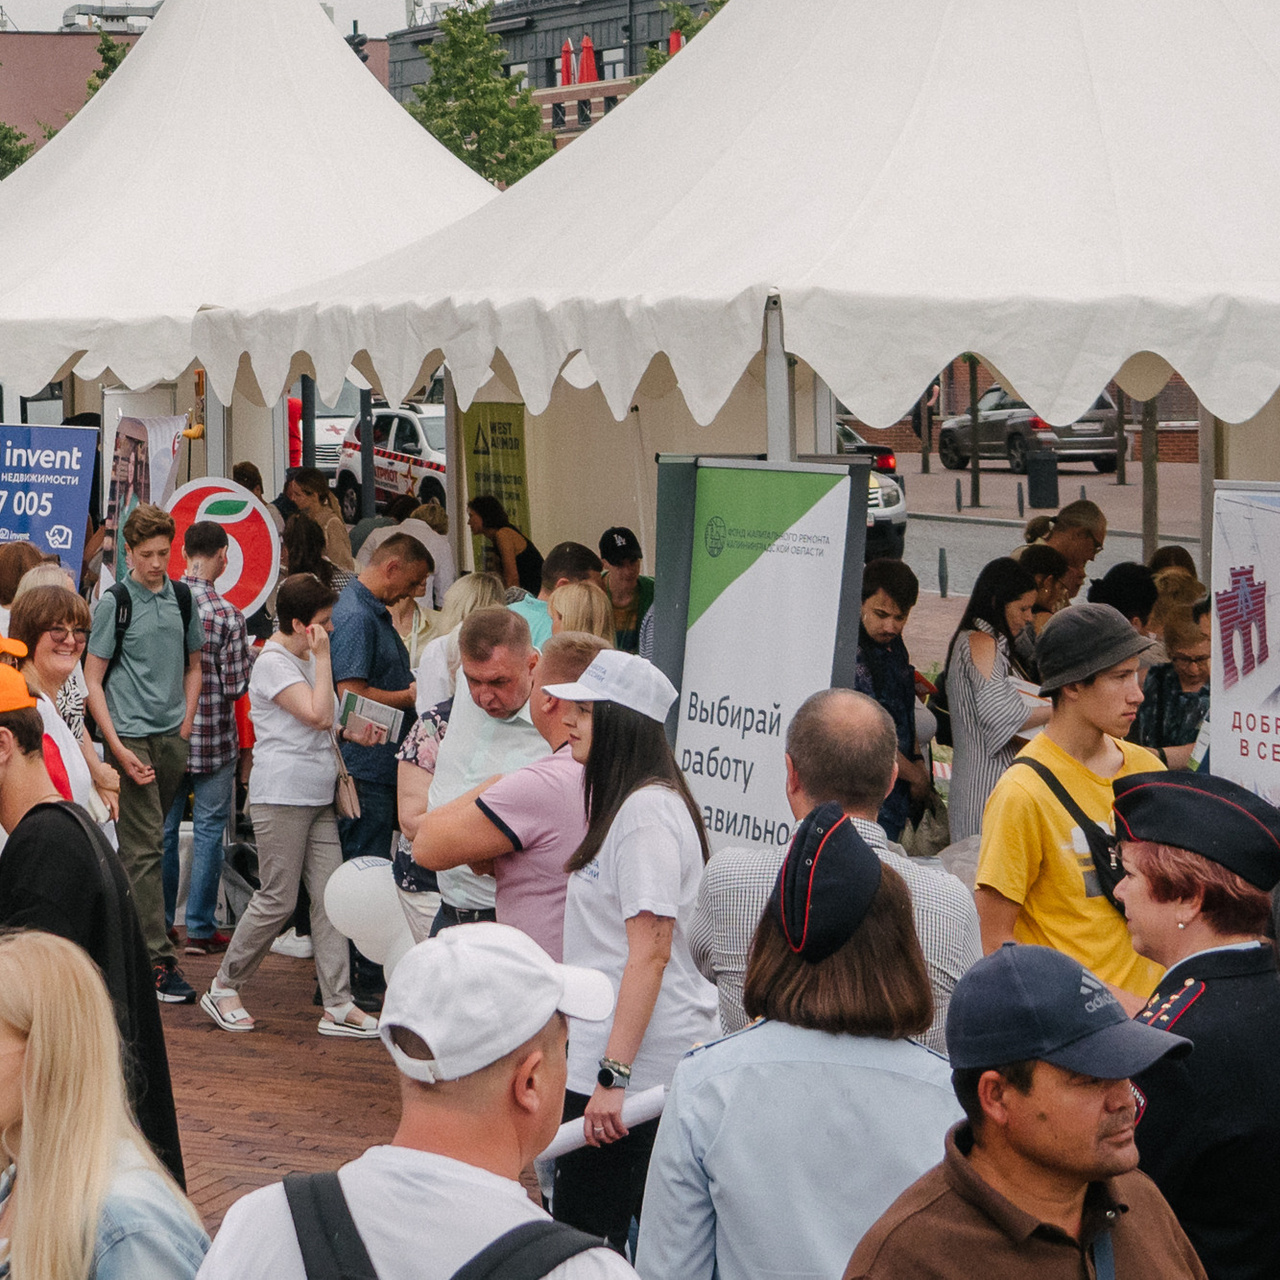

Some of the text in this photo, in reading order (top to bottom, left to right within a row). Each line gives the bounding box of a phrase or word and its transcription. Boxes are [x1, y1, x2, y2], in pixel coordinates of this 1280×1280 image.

[490, 422, 513, 435] WEST
[490, 436, 520, 450] ARMOR
[5, 440, 82, 470] invent
[1, 472, 79, 486] НЕДВИЖИМОСТИ
[13, 491, 53, 517] 005
[9, 530, 30, 541] invent
[728, 528, 830, 544] ФОНД КАПИТАЛЬНОГО РЕМОНТА
[790, 545, 825, 557] ОБЛАСТИ
[687, 691, 782, 740] Выбирай
[681, 746, 755, 794] работу
[703, 804, 790, 846] авильно
